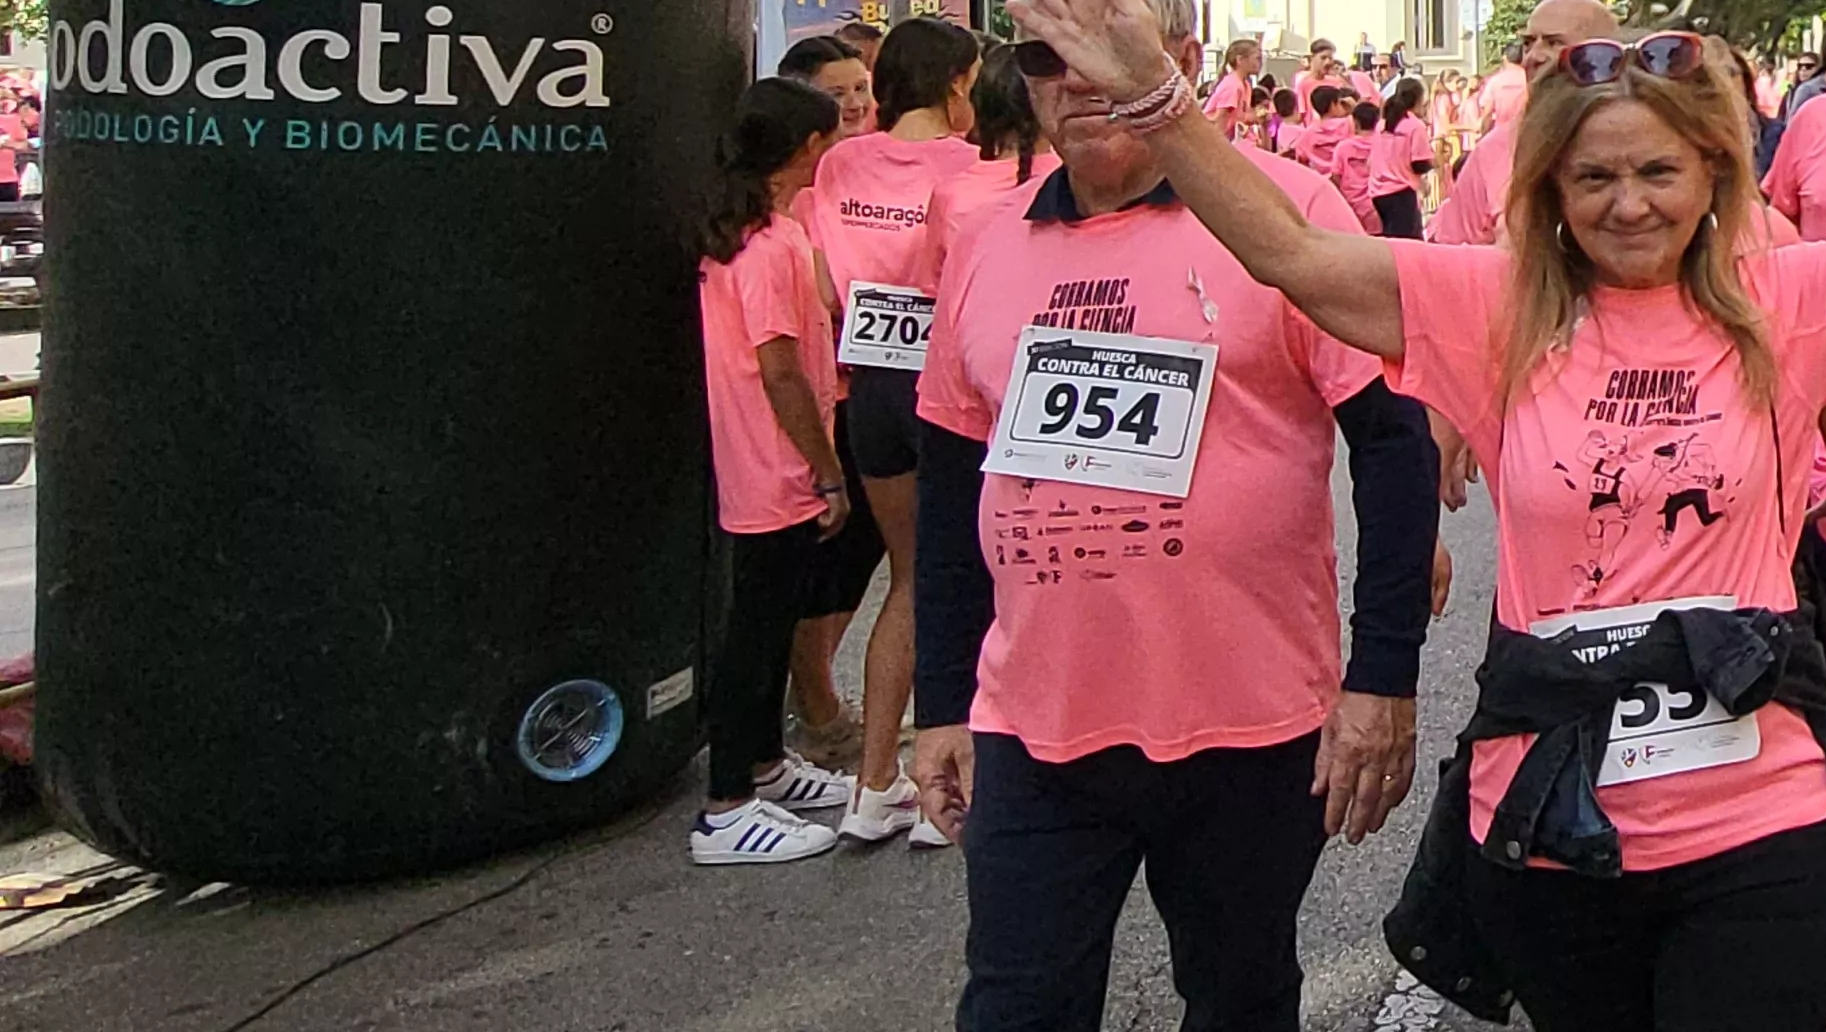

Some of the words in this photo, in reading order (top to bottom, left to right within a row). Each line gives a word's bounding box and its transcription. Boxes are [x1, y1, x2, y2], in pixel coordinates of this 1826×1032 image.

[242, 117, 265, 147] Y
[286, 116, 608, 152] BIOMECÁNICA
[1048, 278, 1130, 310] CORRAMOS
[1037, 357, 1101, 376] CONTRA
[1104, 366, 1121, 378] EL
[1123, 363, 1189, 387] CÁNCER
[1092, 350, 1137, 364] HUESCA
[1038, 382, 1160, 446] 954
[1583, 398, 1619, 424] POR
[1620, 401, 1640, 427] LA
